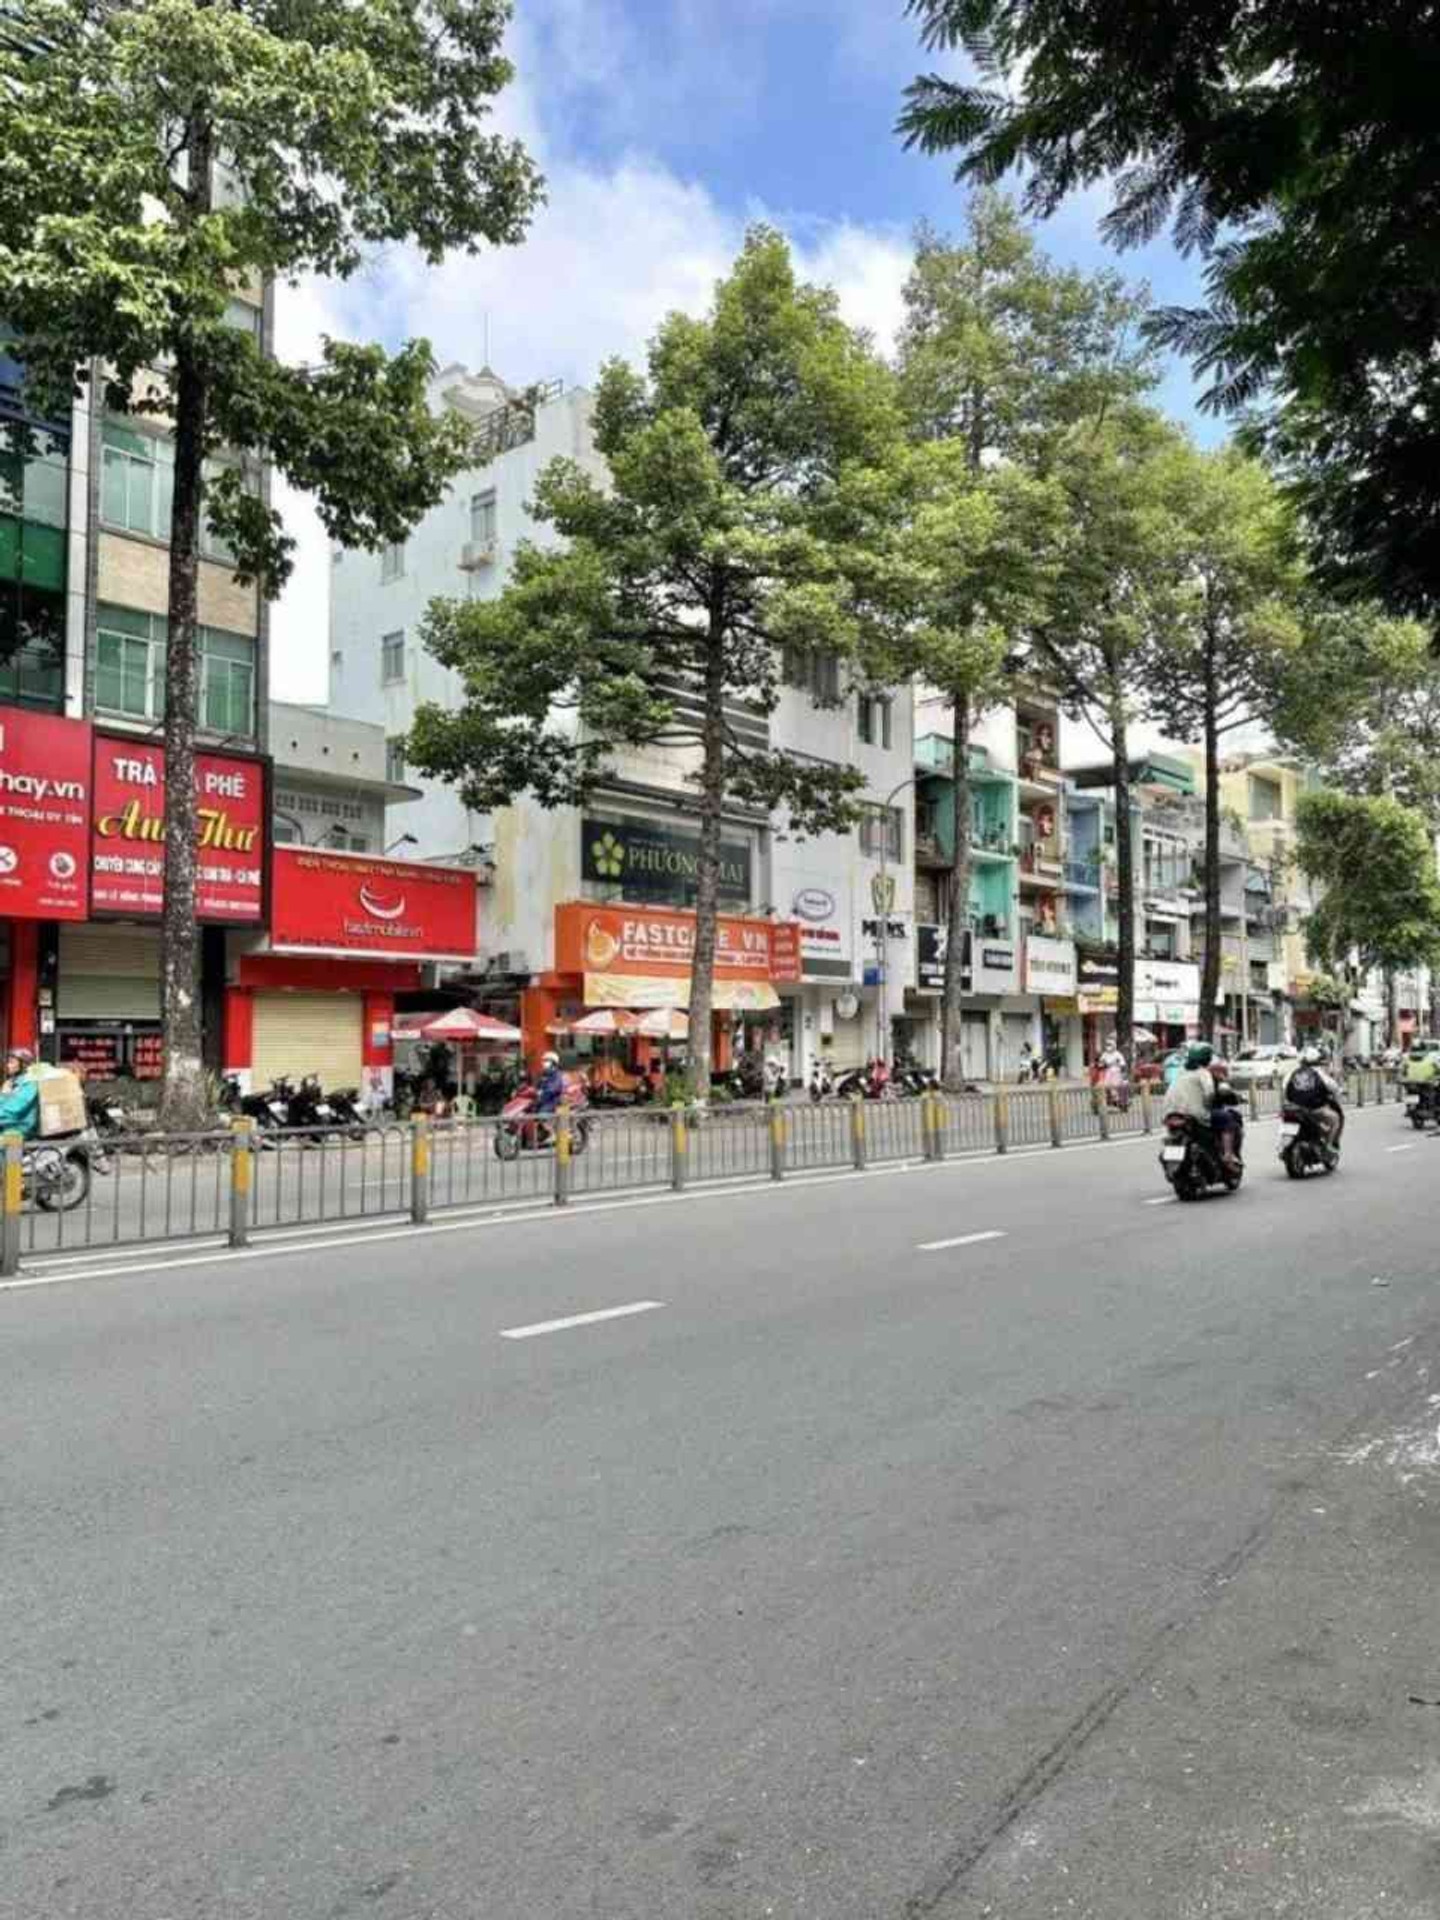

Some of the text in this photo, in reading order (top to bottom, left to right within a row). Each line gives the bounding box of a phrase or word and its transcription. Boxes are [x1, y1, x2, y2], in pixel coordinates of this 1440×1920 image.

[113, 757, 245, 798] TRÀ PHÊ
[628, 845, 699, 875] PHƯƠN
[743, 930, 768, 951] VN
